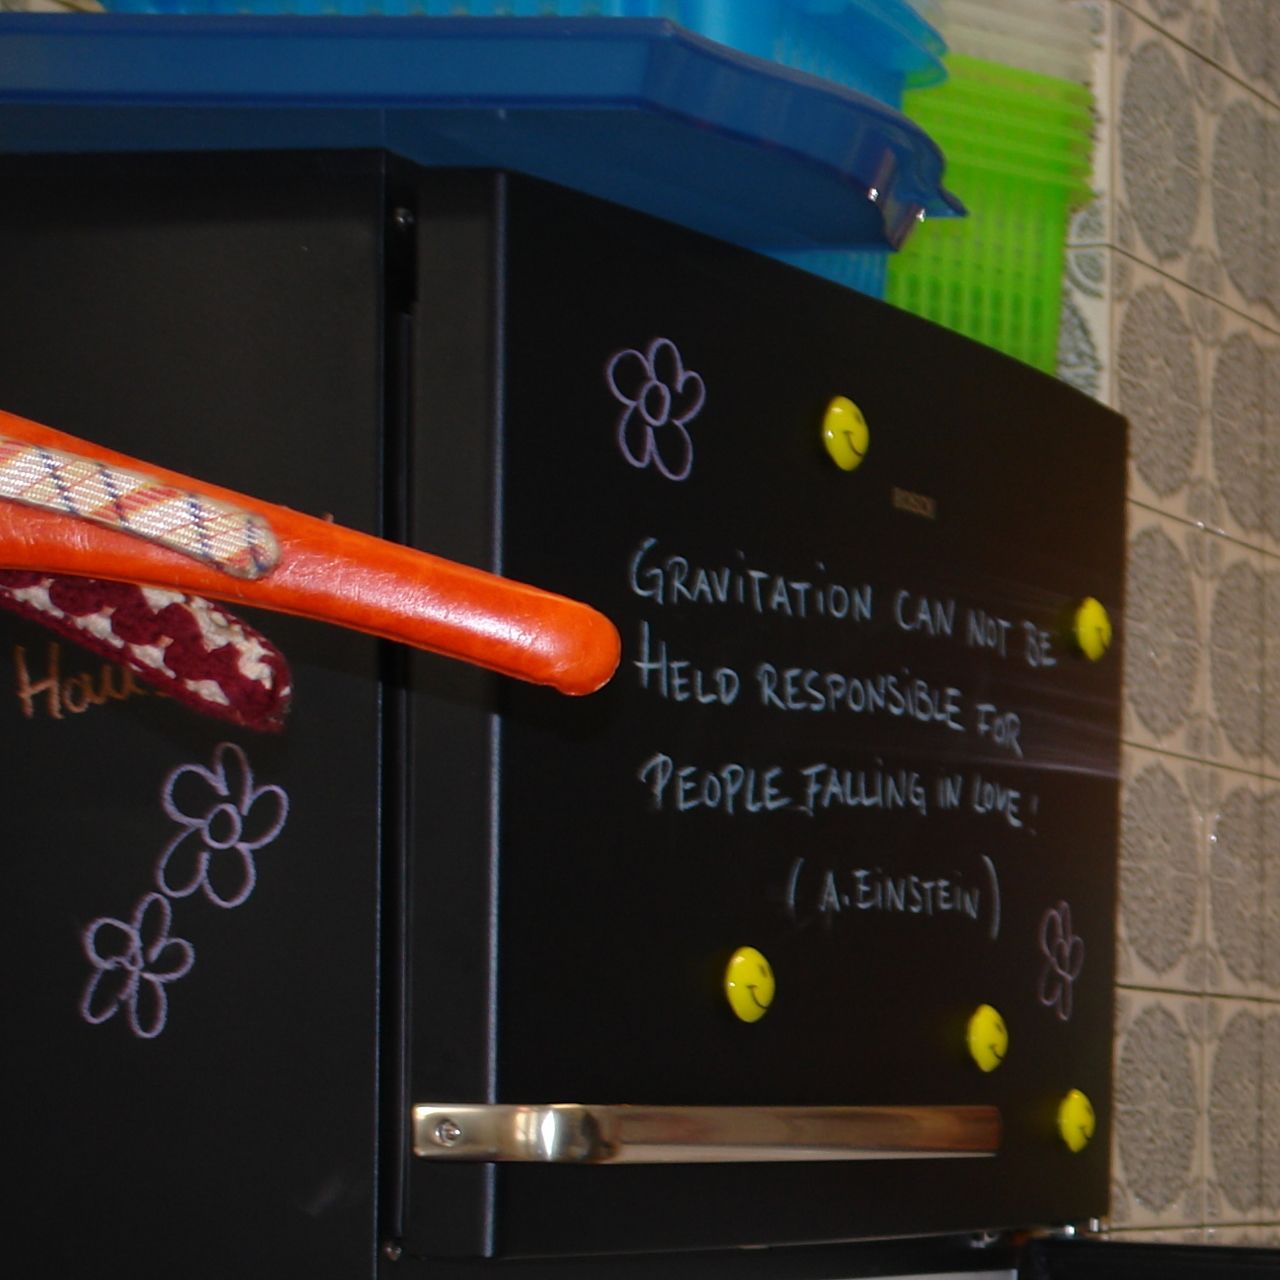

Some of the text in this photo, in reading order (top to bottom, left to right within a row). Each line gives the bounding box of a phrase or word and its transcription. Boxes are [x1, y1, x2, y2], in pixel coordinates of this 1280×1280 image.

[894, 590, 955, 636] CAN
[967, 608, 1013, 658] NOT
[1024, 621, 1058, 668] BE
[634, 620, 740, 705] HELD
[975, 703, 1025, 759] FOR
[639, 752, 794, 814] PEOPLE
[937, 774, 963, 808] IN
